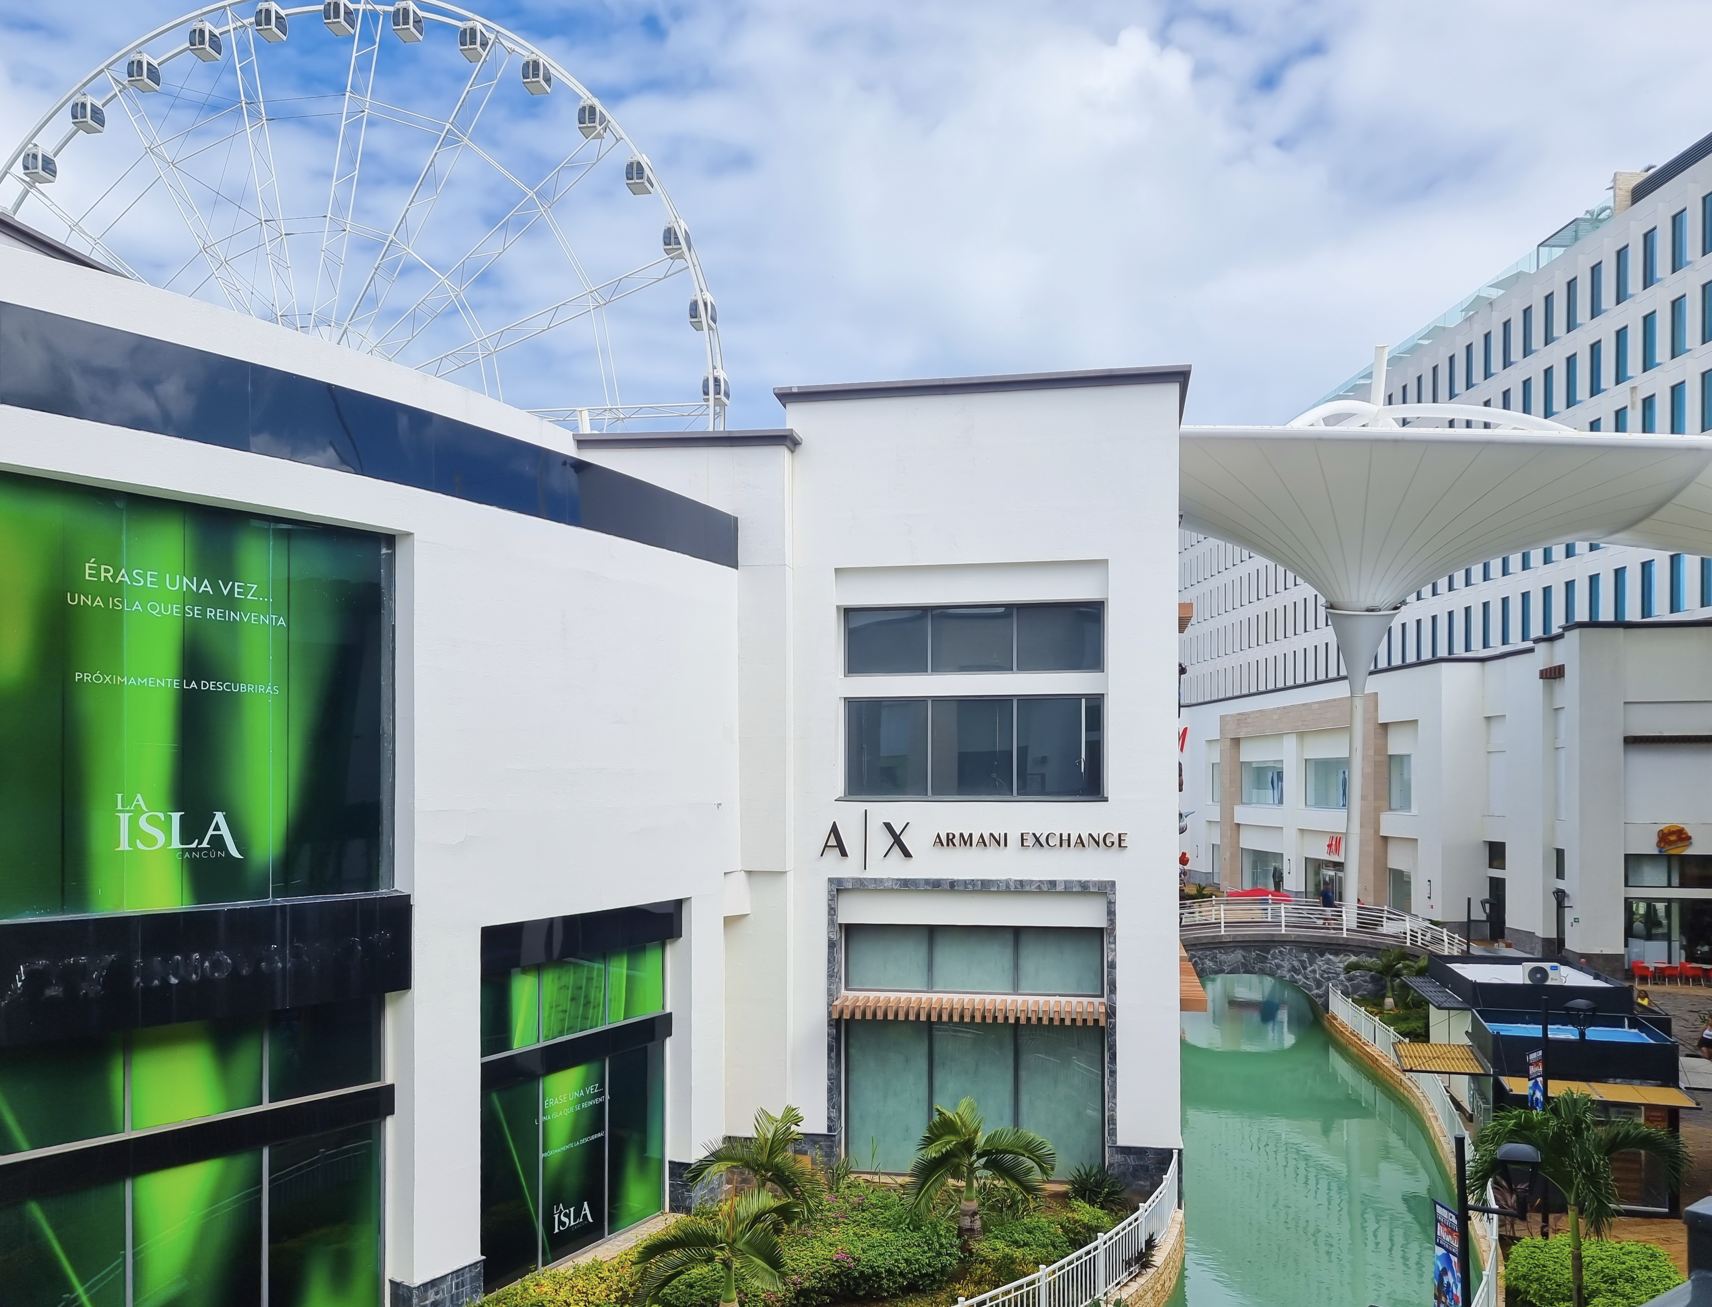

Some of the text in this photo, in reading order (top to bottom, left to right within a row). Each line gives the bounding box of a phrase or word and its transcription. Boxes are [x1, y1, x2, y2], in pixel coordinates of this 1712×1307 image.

[85, 558, 273, 602] ÉRASE UNA VEZ...
[67, 592, 287, 628] UNA ISLA QUE SE REINVENTA
[75, 671, 279, 695] PRÓXIMAMENTE LA DESCUBRIRÁS
[116, 793, 149, 812] LA
[114, 811, 244, 859] ISLA
[932, 832, 1008, 848] ARMANI
[1021, 832, 1129, 849] EXCHANGE
[176, 849, 225, 860] CANCÚN
[544, 1094, 567, 1109] ÉRASE
[568, 1089, 585, 1101] UNA
[553, 1203, 564, 1214] LA
[553, 1201, 594, 1234] ISLA
